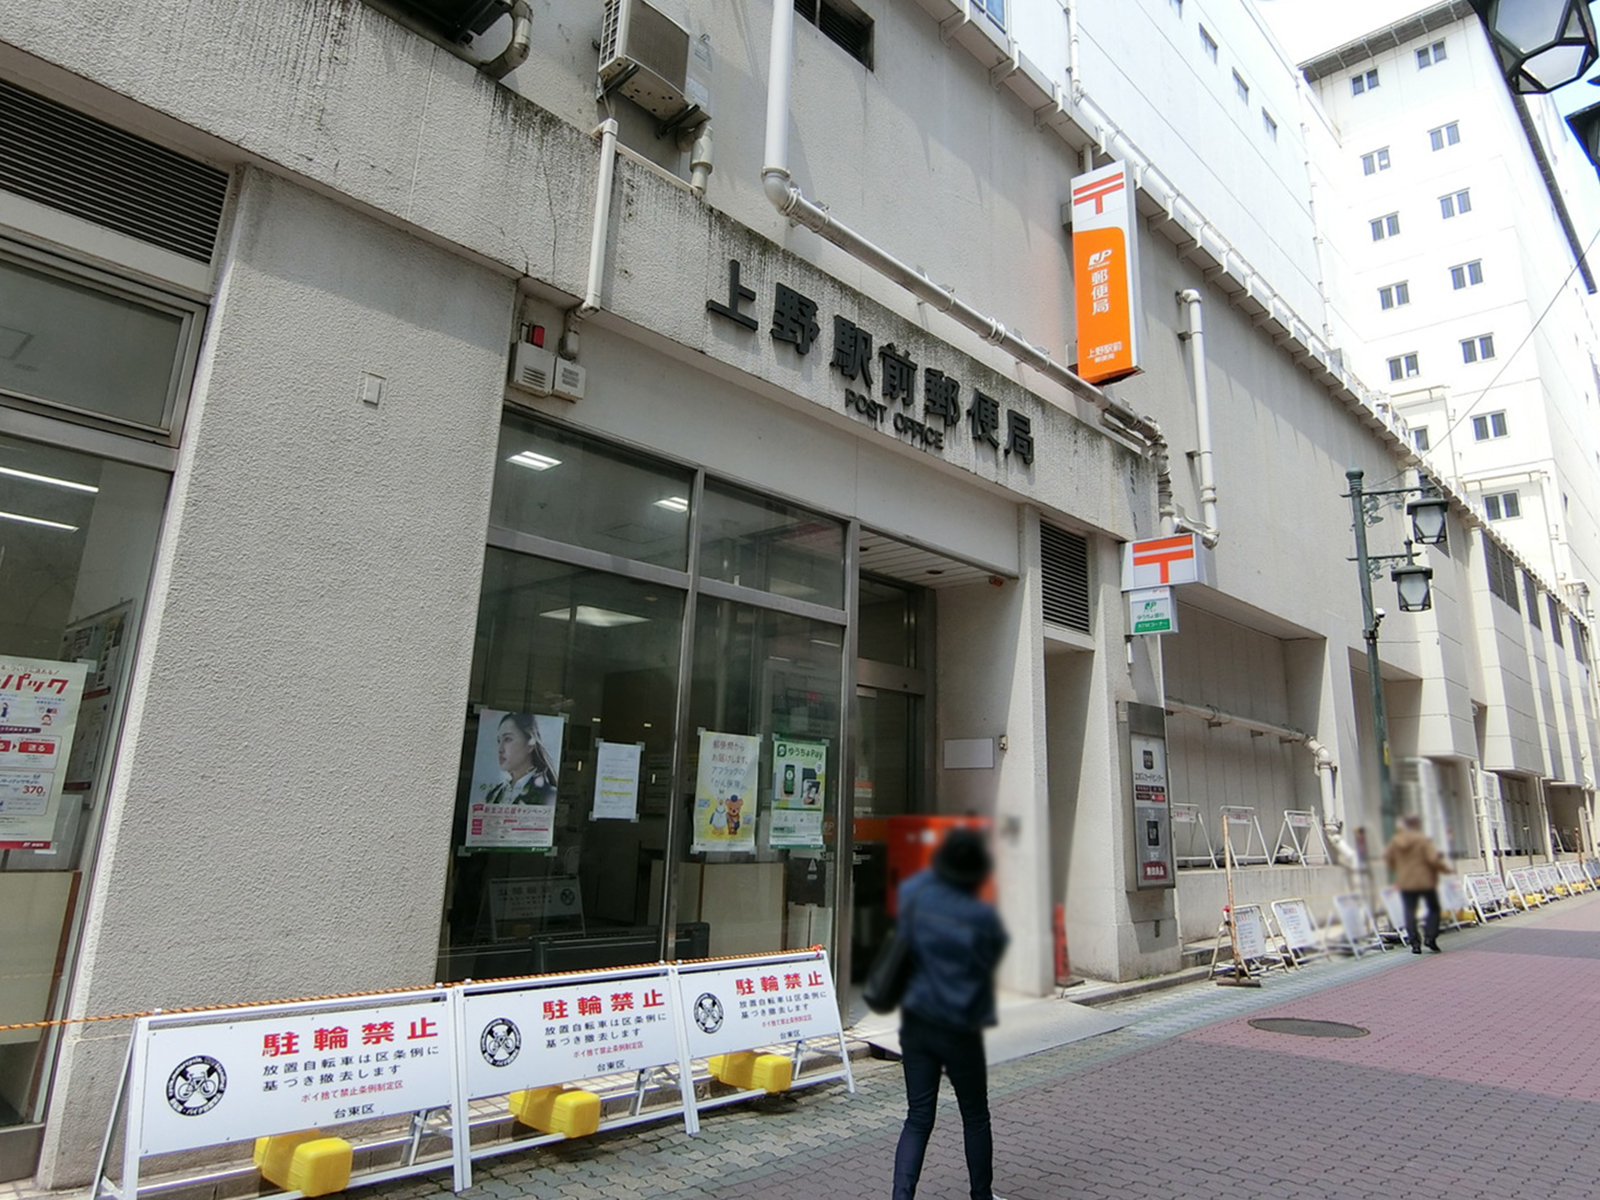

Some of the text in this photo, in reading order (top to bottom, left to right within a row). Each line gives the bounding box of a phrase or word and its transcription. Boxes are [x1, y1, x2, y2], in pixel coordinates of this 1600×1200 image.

[1091, 268, 1109, 316] 郵便局
[706, 258, 1035, 465] 上野駅前郵便局
[1086, 340, 1122, 360] 上野駅前
[845, 387, 944, 450] POST OFFICE
[788, 747, 824, 760] ゆうちょPay
[735, 970, 824, 996] 駐輪禁止
[542, 989, 665, 1020] 駐輪禁止
[739, 991, 827, 1009] 放置自転車は区条例に
[741, 1003, 808, 1019] 基づき撤去します
[545, 1013, 666, 1036] 放置自転車は区条例に
[262, 1017, 438, 1057] 駐輪禁止
[546, 1028, 641, 1048] 基づき撤去します
[263, 1046, 439, 1076] 放置自転車は区条例に
[596, 1060, 625, 1072] 台東区
[263, 1065, 402, 1092] 基づき撤去します
[301, 1080, 403, 1103] ポイ捨て禁止条例制定区
[333, 1103, 375, 1119] 台東区
